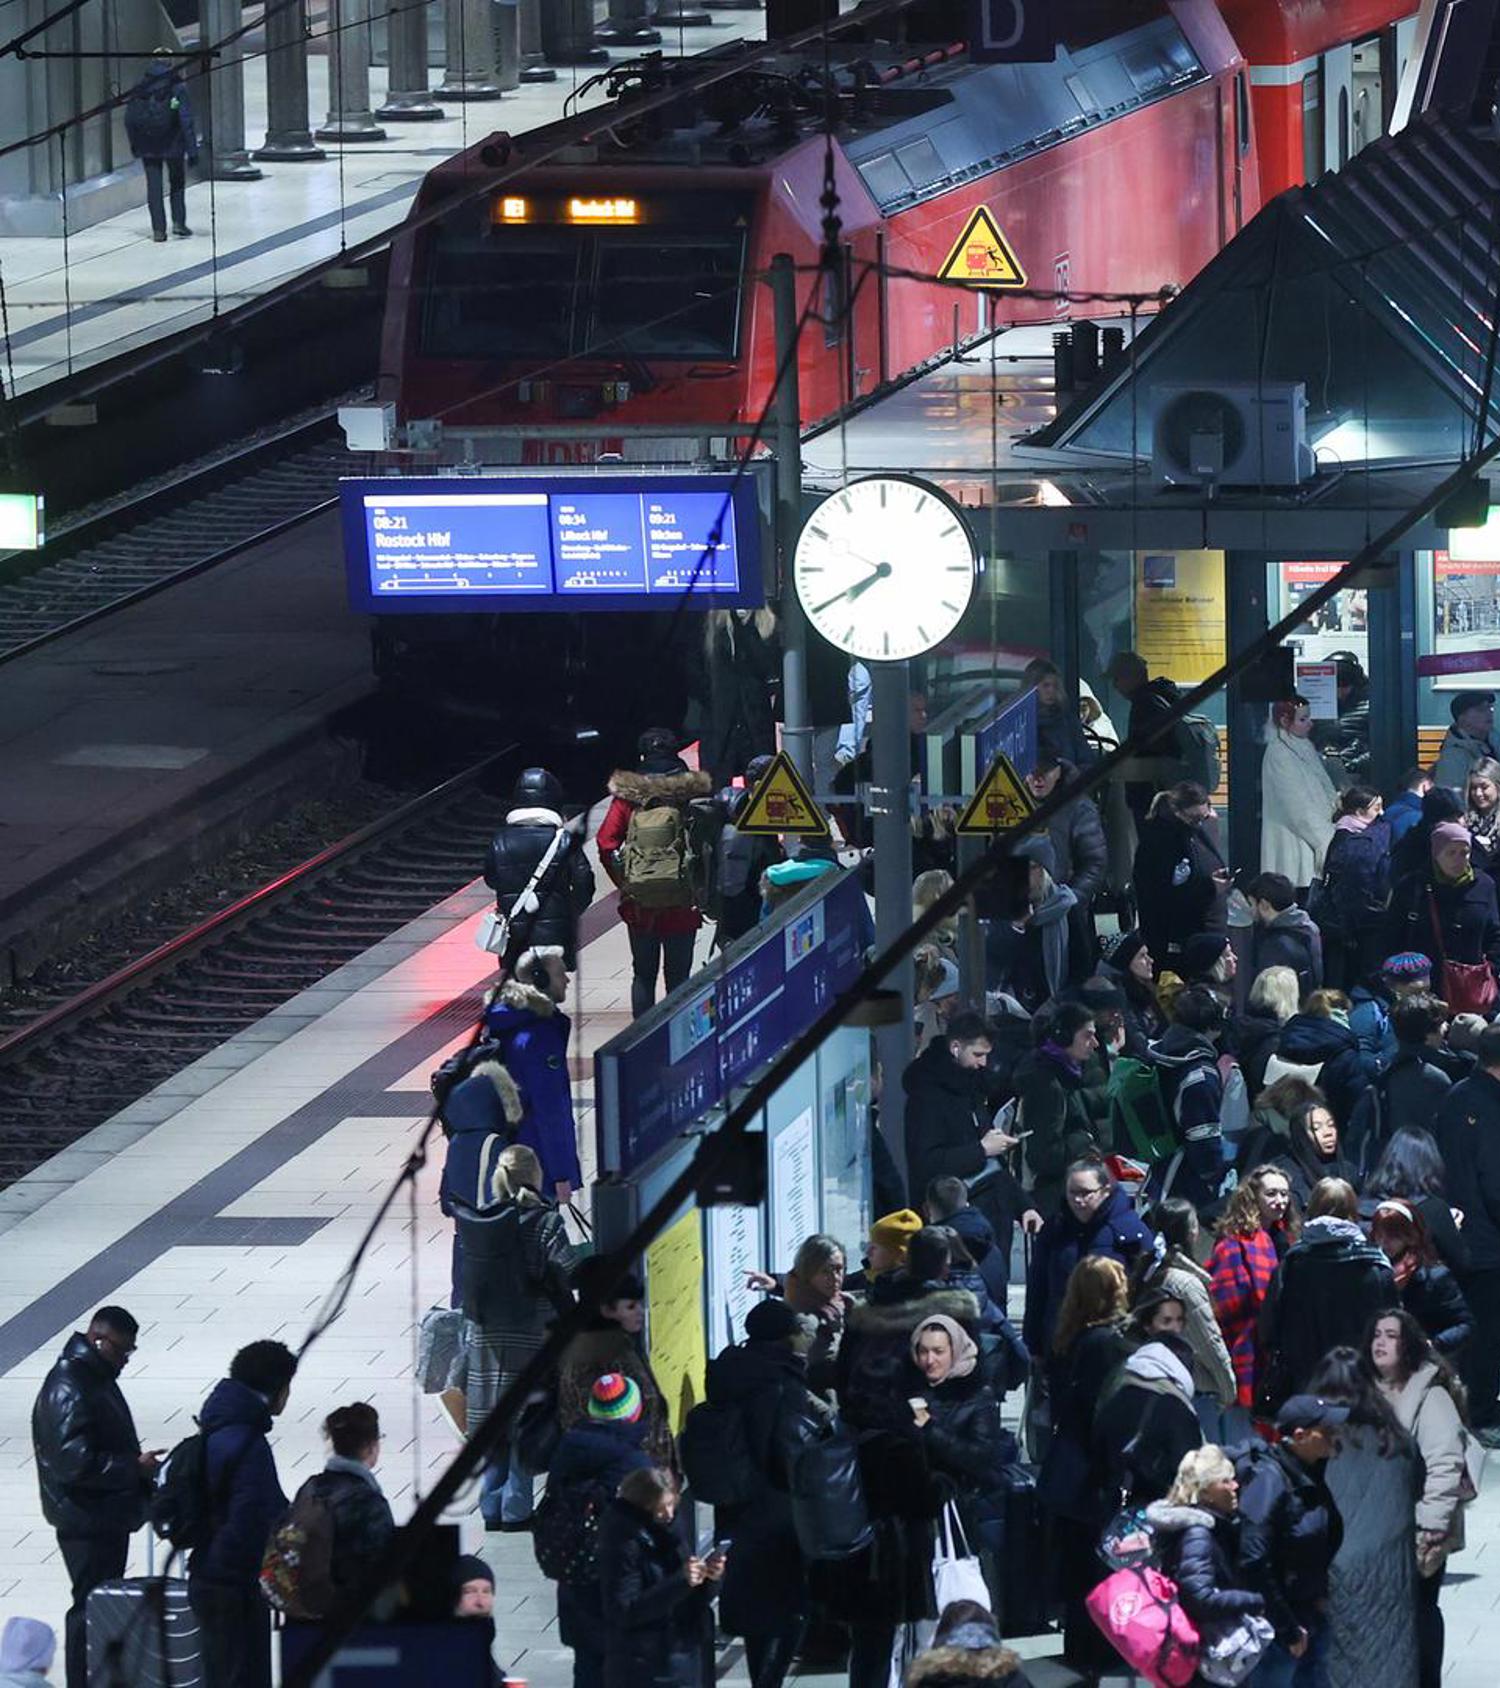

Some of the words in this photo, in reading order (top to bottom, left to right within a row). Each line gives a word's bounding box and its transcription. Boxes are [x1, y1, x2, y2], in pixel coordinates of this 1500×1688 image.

[982, 0, 1025, 49] D
[375, 531, 425, 548] Rostock
[426, 531, 451, 548] Hbf
